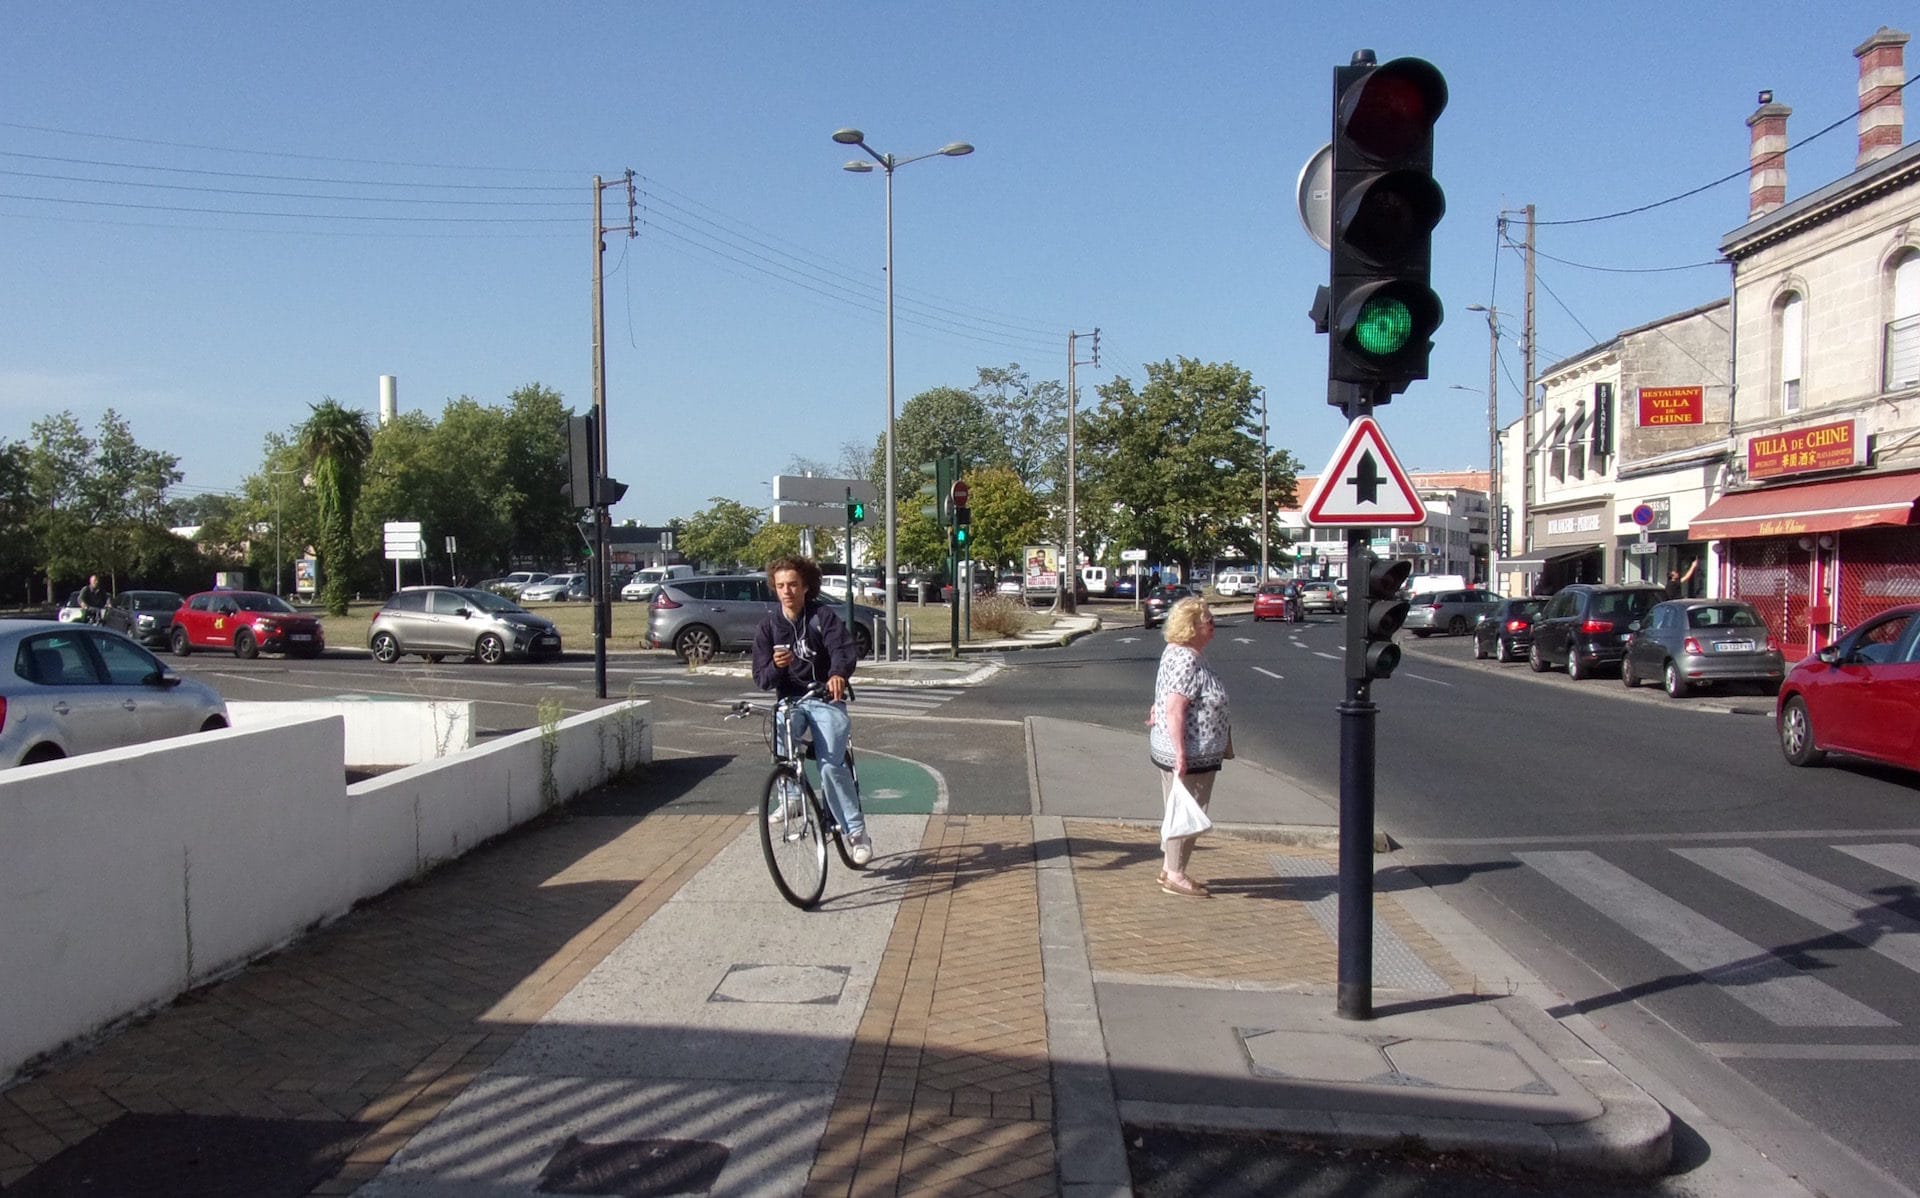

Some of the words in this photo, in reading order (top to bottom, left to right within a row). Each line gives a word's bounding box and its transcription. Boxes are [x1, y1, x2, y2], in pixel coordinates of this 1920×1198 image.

[1642, 389, 1699, 398] RESTAURANT
[1652, 398, 1690, 408] VILLA
[1650, 414, 1692, 424] CHINE
[1754, 437, 1788, 456] VILLA
[1791, 438, 1804, 451] DE
[1806, 426, 1849, 448] CHINE
